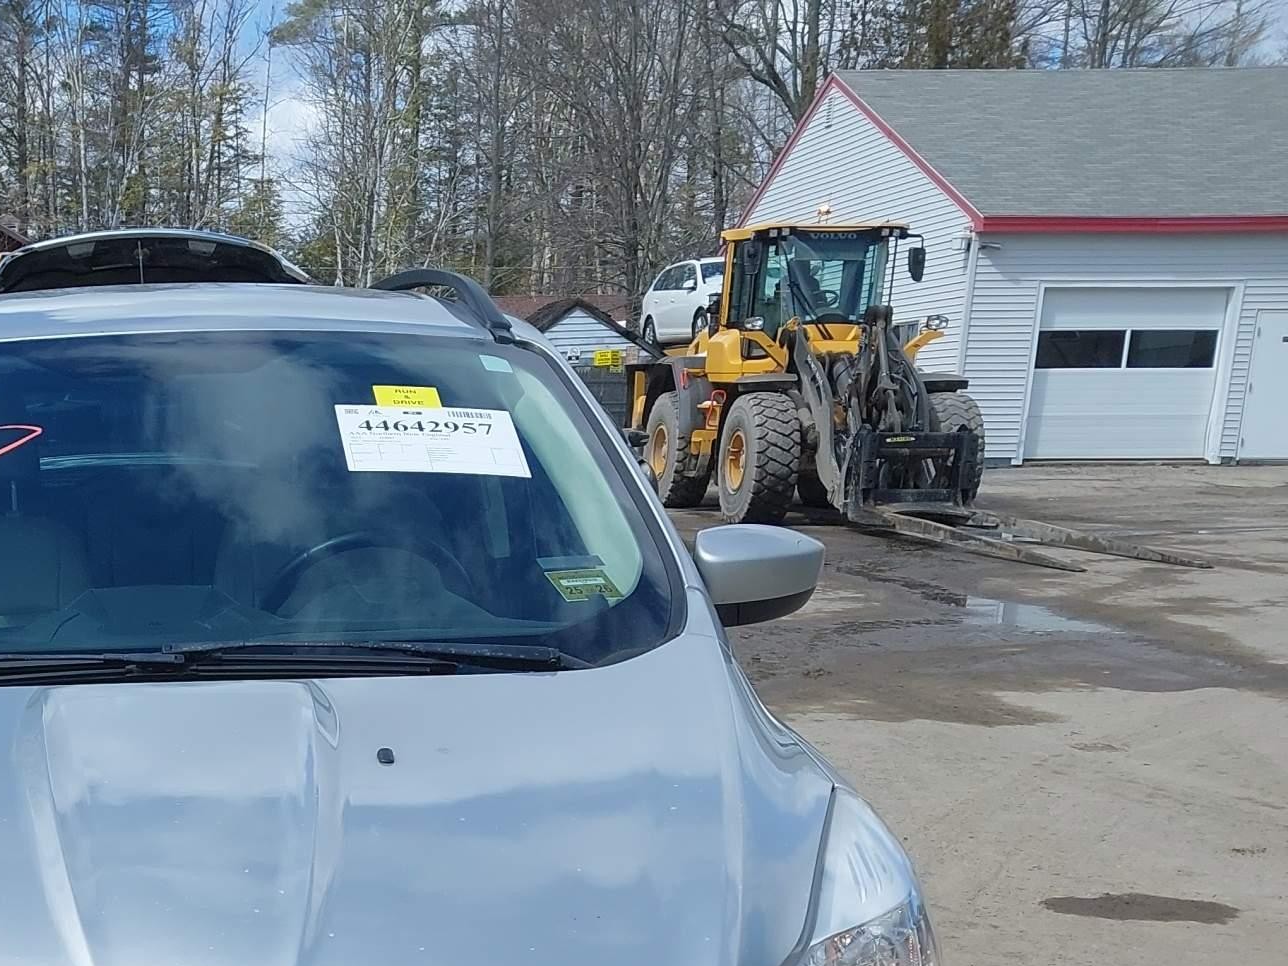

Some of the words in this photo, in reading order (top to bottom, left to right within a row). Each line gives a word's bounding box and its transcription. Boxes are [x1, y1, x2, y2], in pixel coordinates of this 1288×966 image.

[810, 232, 857, 240] VOLVO
[358, 418, 492, 436] 44642957
[566, 586, 583, 595] 25
